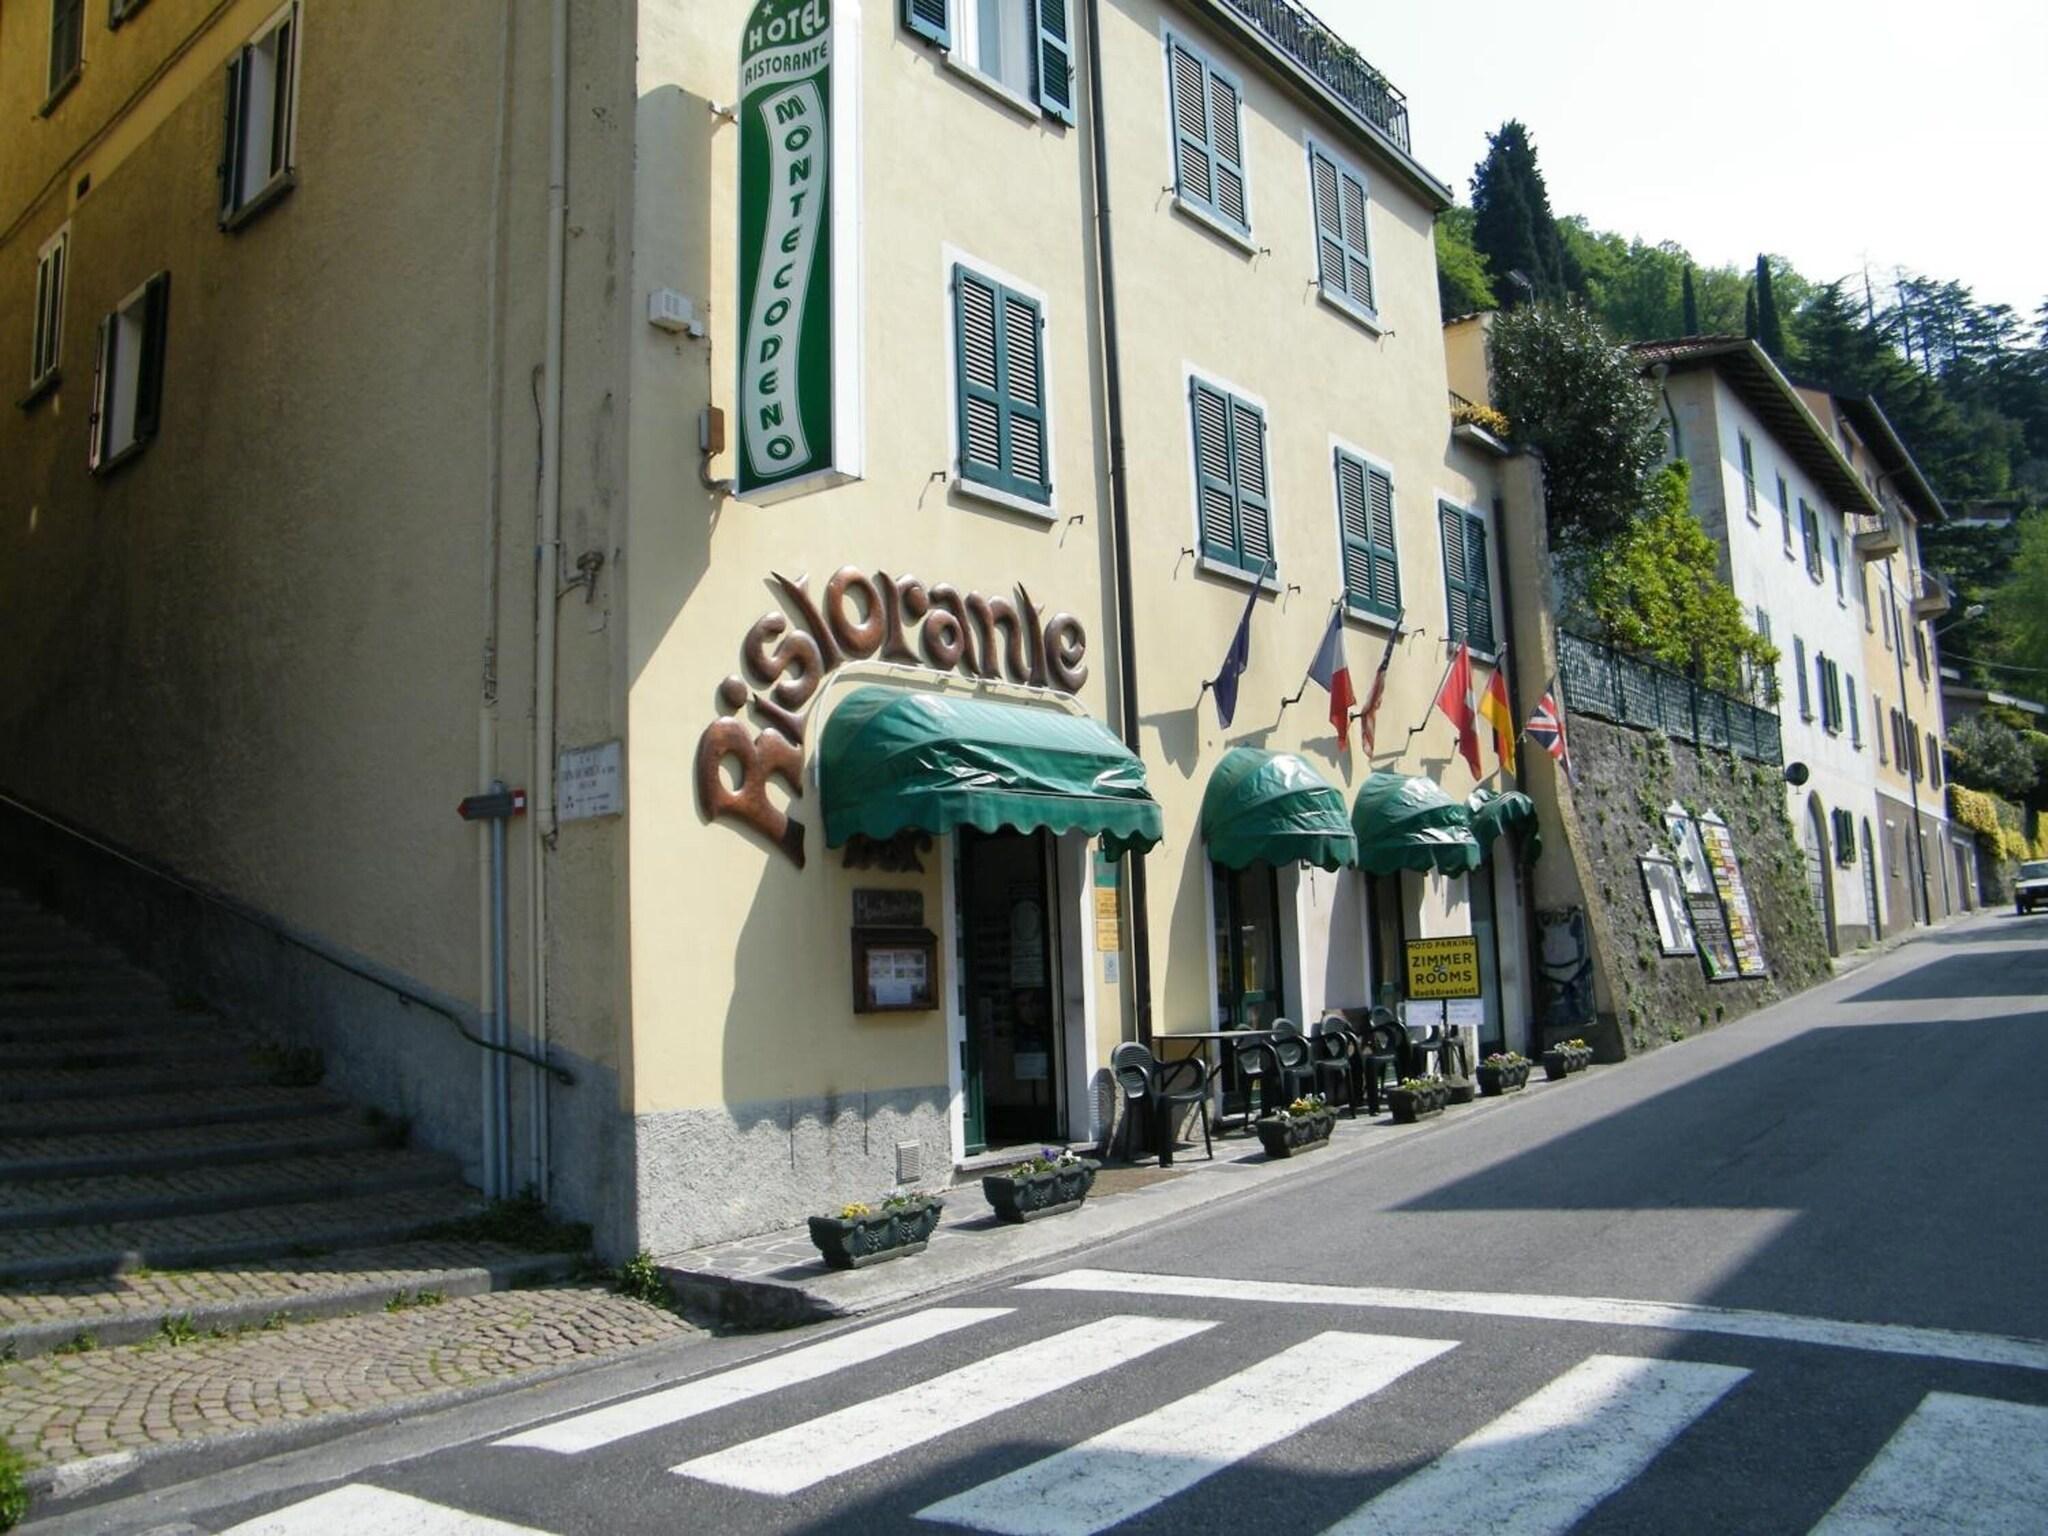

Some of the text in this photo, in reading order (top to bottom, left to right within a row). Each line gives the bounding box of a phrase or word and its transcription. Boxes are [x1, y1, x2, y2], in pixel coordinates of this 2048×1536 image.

[748, 0, 825, 51] HOTEL
[744, 41, 828, 86] RISTORANTE
[758, 94, 812, 460] MONTECODENO
[698, 565, 1088, 869] Ristorante
[1411, 953, 1472, 967] ZIMMER
[1435, 940, 1475, 949] PARKING
[1415, 971, 1472, 984] ROOMS
